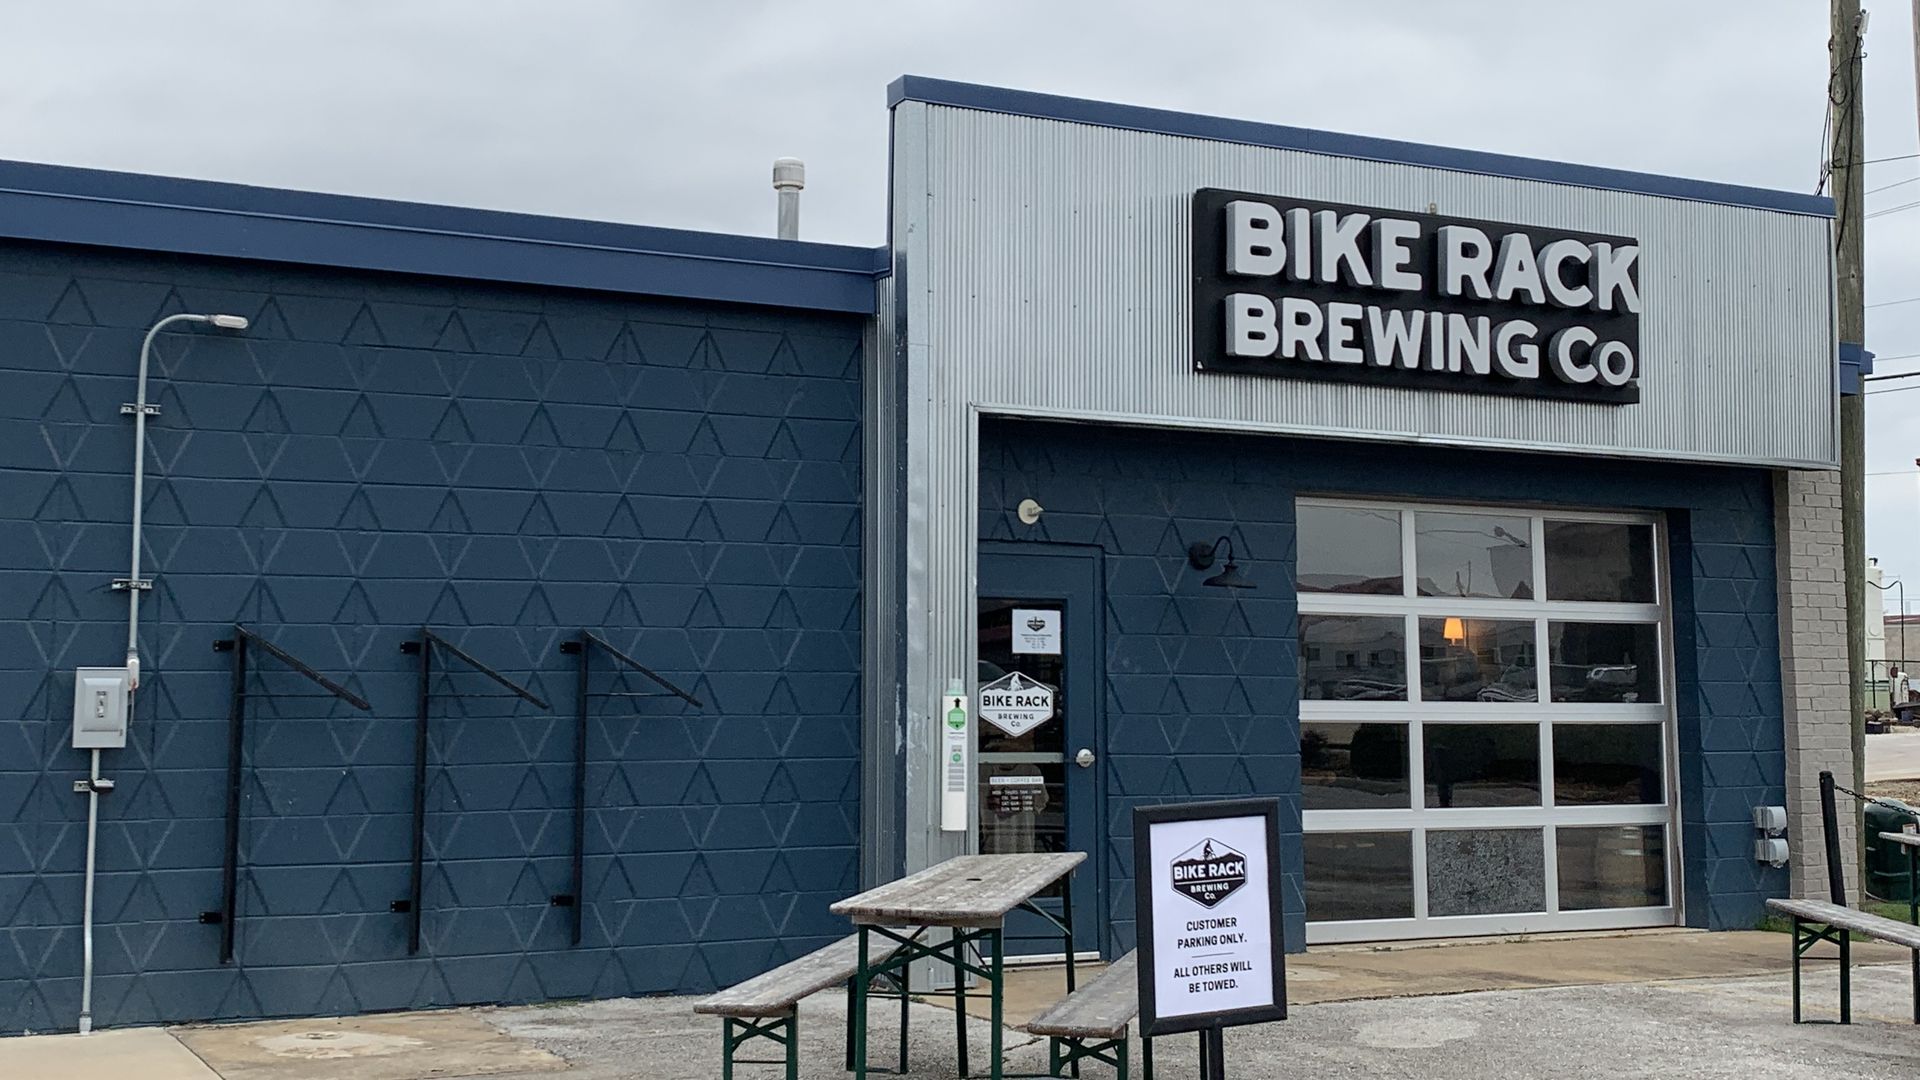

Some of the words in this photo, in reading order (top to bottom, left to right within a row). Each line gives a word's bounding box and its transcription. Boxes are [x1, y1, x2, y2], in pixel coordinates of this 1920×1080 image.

[1226, 201, 1422, 291] BIKE
[1437, 225, 1640, 314] RACK
[1226, 293, 1539, 379] BREWING
[983, 695, 1012, 707] BIKE
[1016, 695, 1049, 707] RACK
[1173, 864, 1206, 880] BIKE
[1208, 861, 1244, 877] RACK
[1190, 882, 1229, 893] BREWING
[1186, 917, 1237, 931] CUSTOMER
[1177, 935, 1218, 949] PARKING
[1219, 933, 1247, 945] ONLY.
[1173, 967, 1190, 978] ALL
[1192, 963, 1228, 976] OTHERS
[1230, 960, 1252, 972] WILL
[1189, 982, 1200, 993] BE
[1202, 979, 1238, 992] TOWED.
